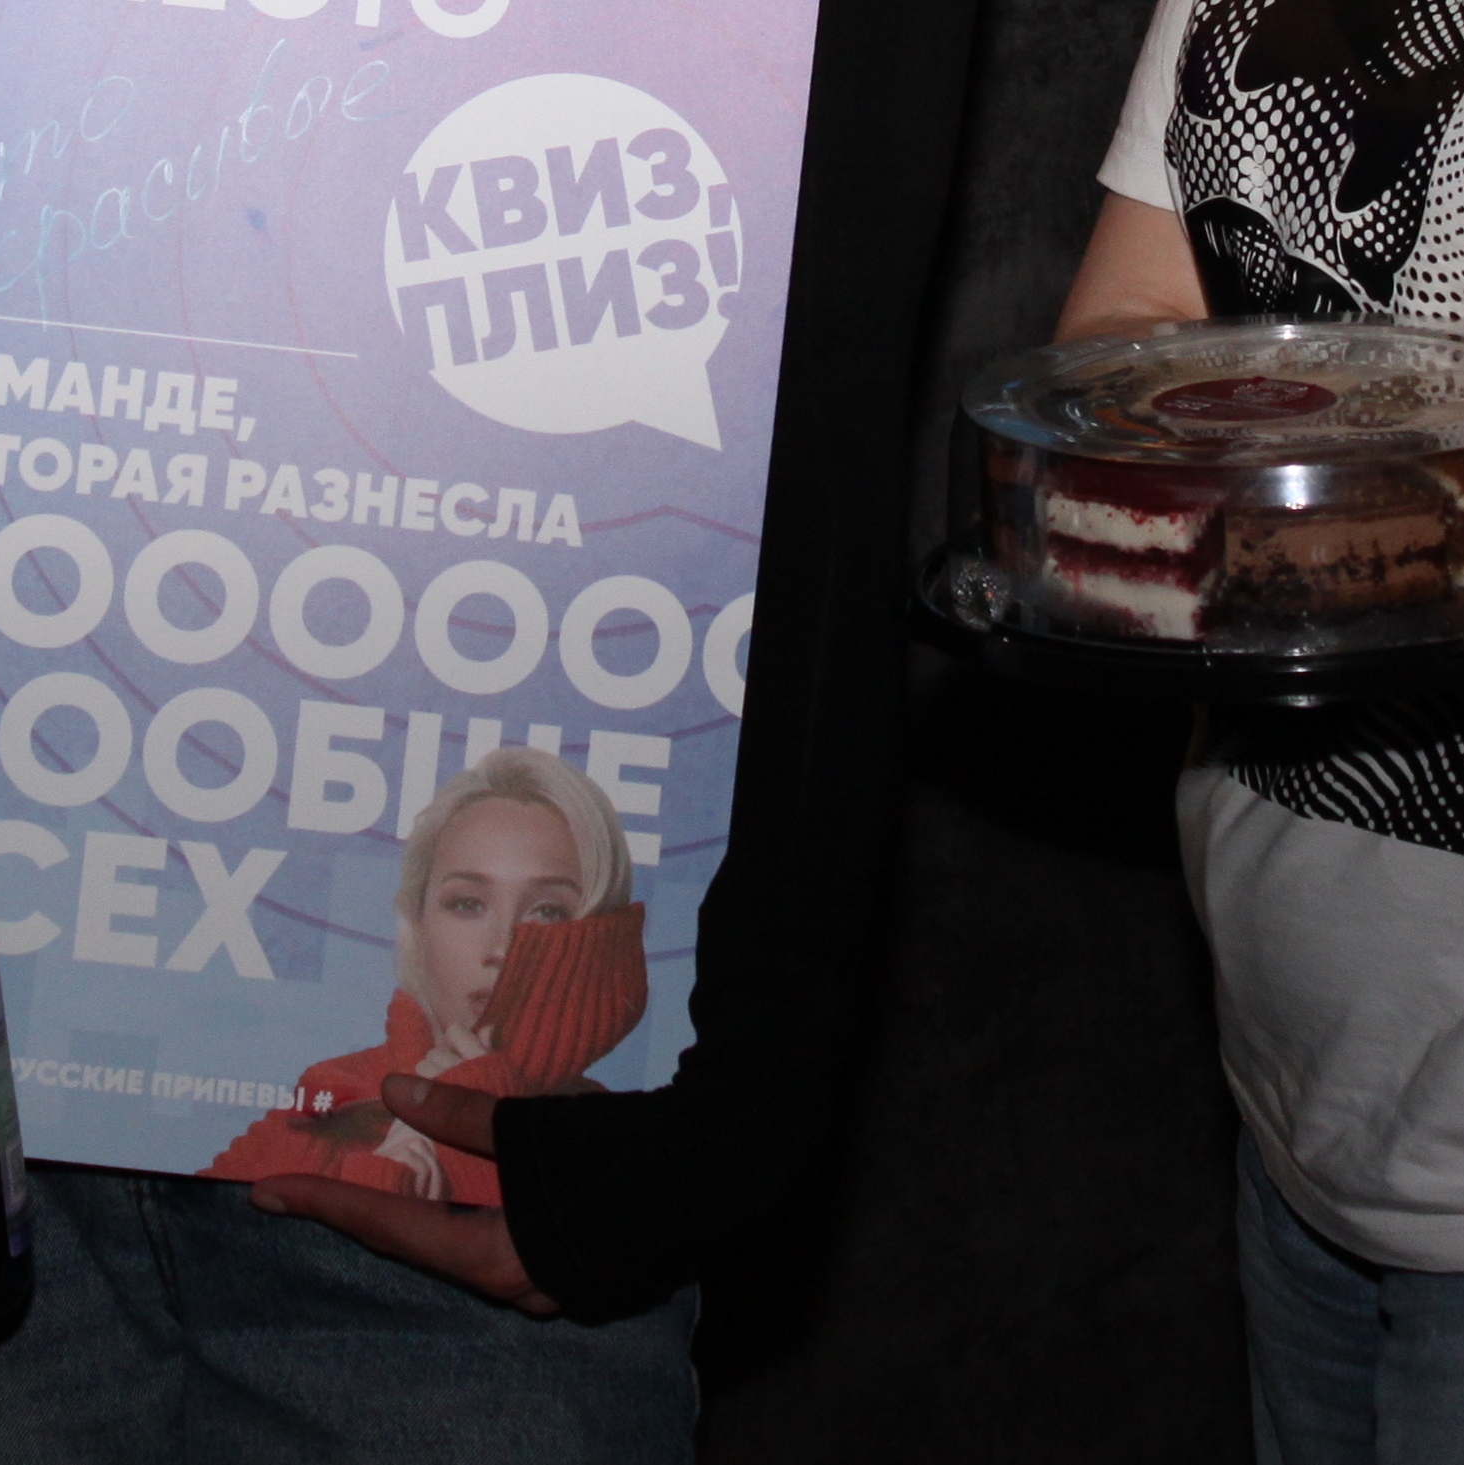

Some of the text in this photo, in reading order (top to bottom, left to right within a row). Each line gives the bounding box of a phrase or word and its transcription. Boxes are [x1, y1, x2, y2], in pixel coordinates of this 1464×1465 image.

[397, 230, 740, 367] ПЛИЗ!
[224, 457, 584, 548] РАЗНЕСЛА
[11, 1058, 143, 1096] УССКИЕ
[151, 1071, 305, 1113] ПРИПЕВЫ
